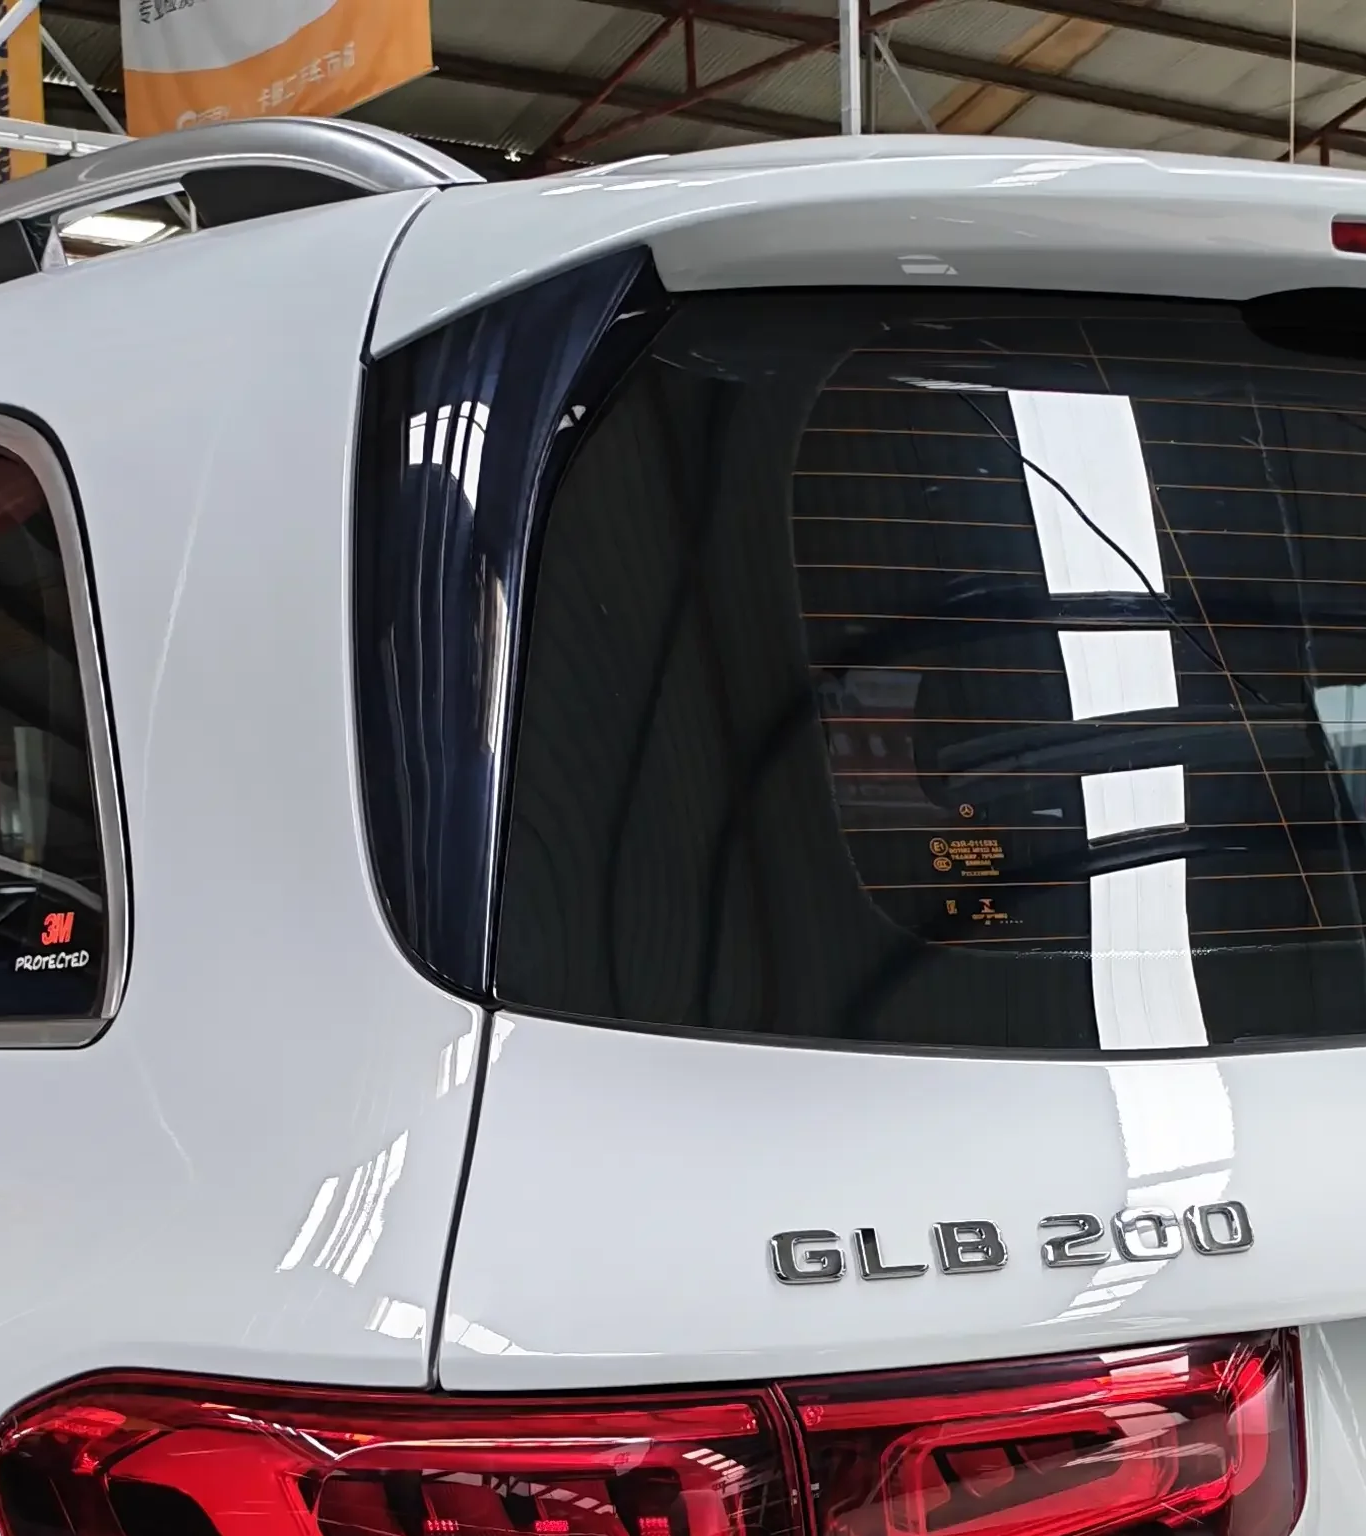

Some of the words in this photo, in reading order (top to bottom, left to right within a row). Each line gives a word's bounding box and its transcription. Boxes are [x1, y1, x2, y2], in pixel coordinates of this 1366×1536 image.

[41, 911, 75, 946] 3M
[15, 949, 90, 972] PROTECTED
[769, 1218, 1011, 1285] GLB
[1037, 1199, 1256, 1268] 200
